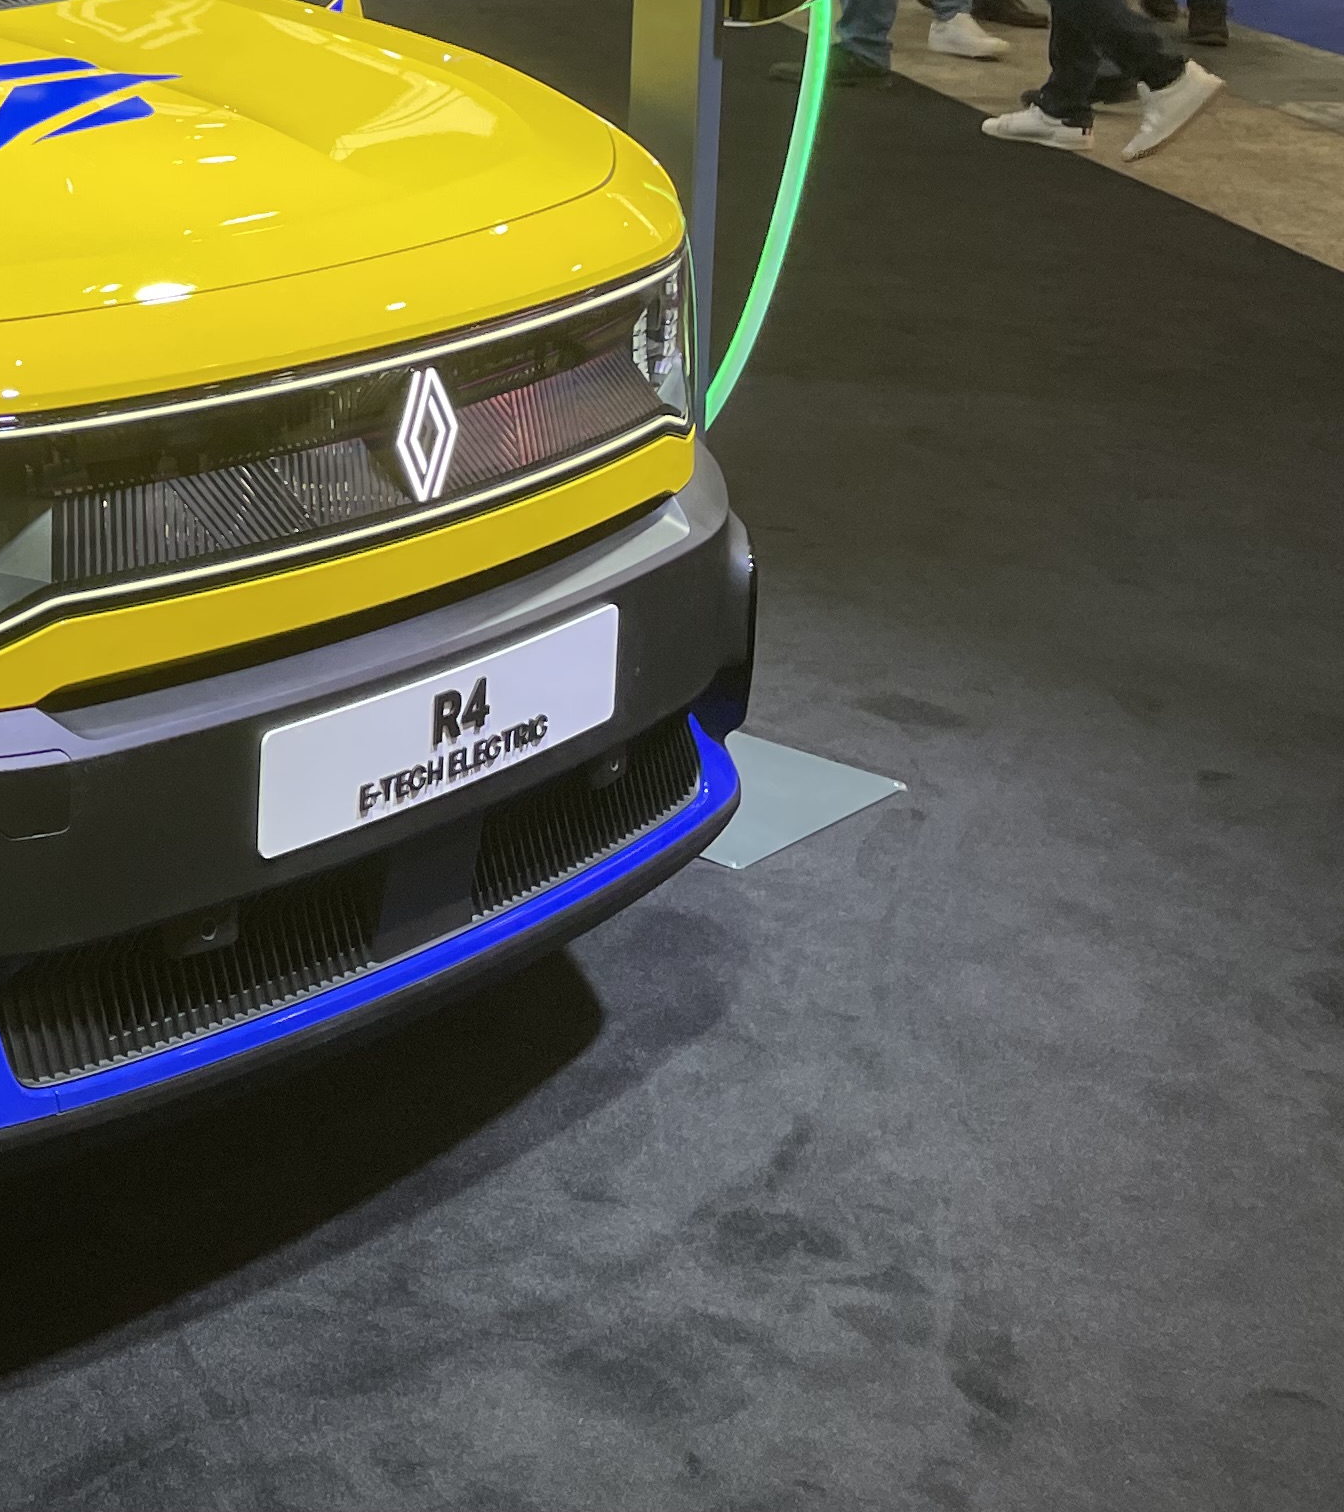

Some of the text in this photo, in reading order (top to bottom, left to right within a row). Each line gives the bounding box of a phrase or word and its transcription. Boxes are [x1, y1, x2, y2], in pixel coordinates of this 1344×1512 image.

[431, 675, 490, 750] R4
[359, 714, 548, 813] E-TECH ELECTRIC
